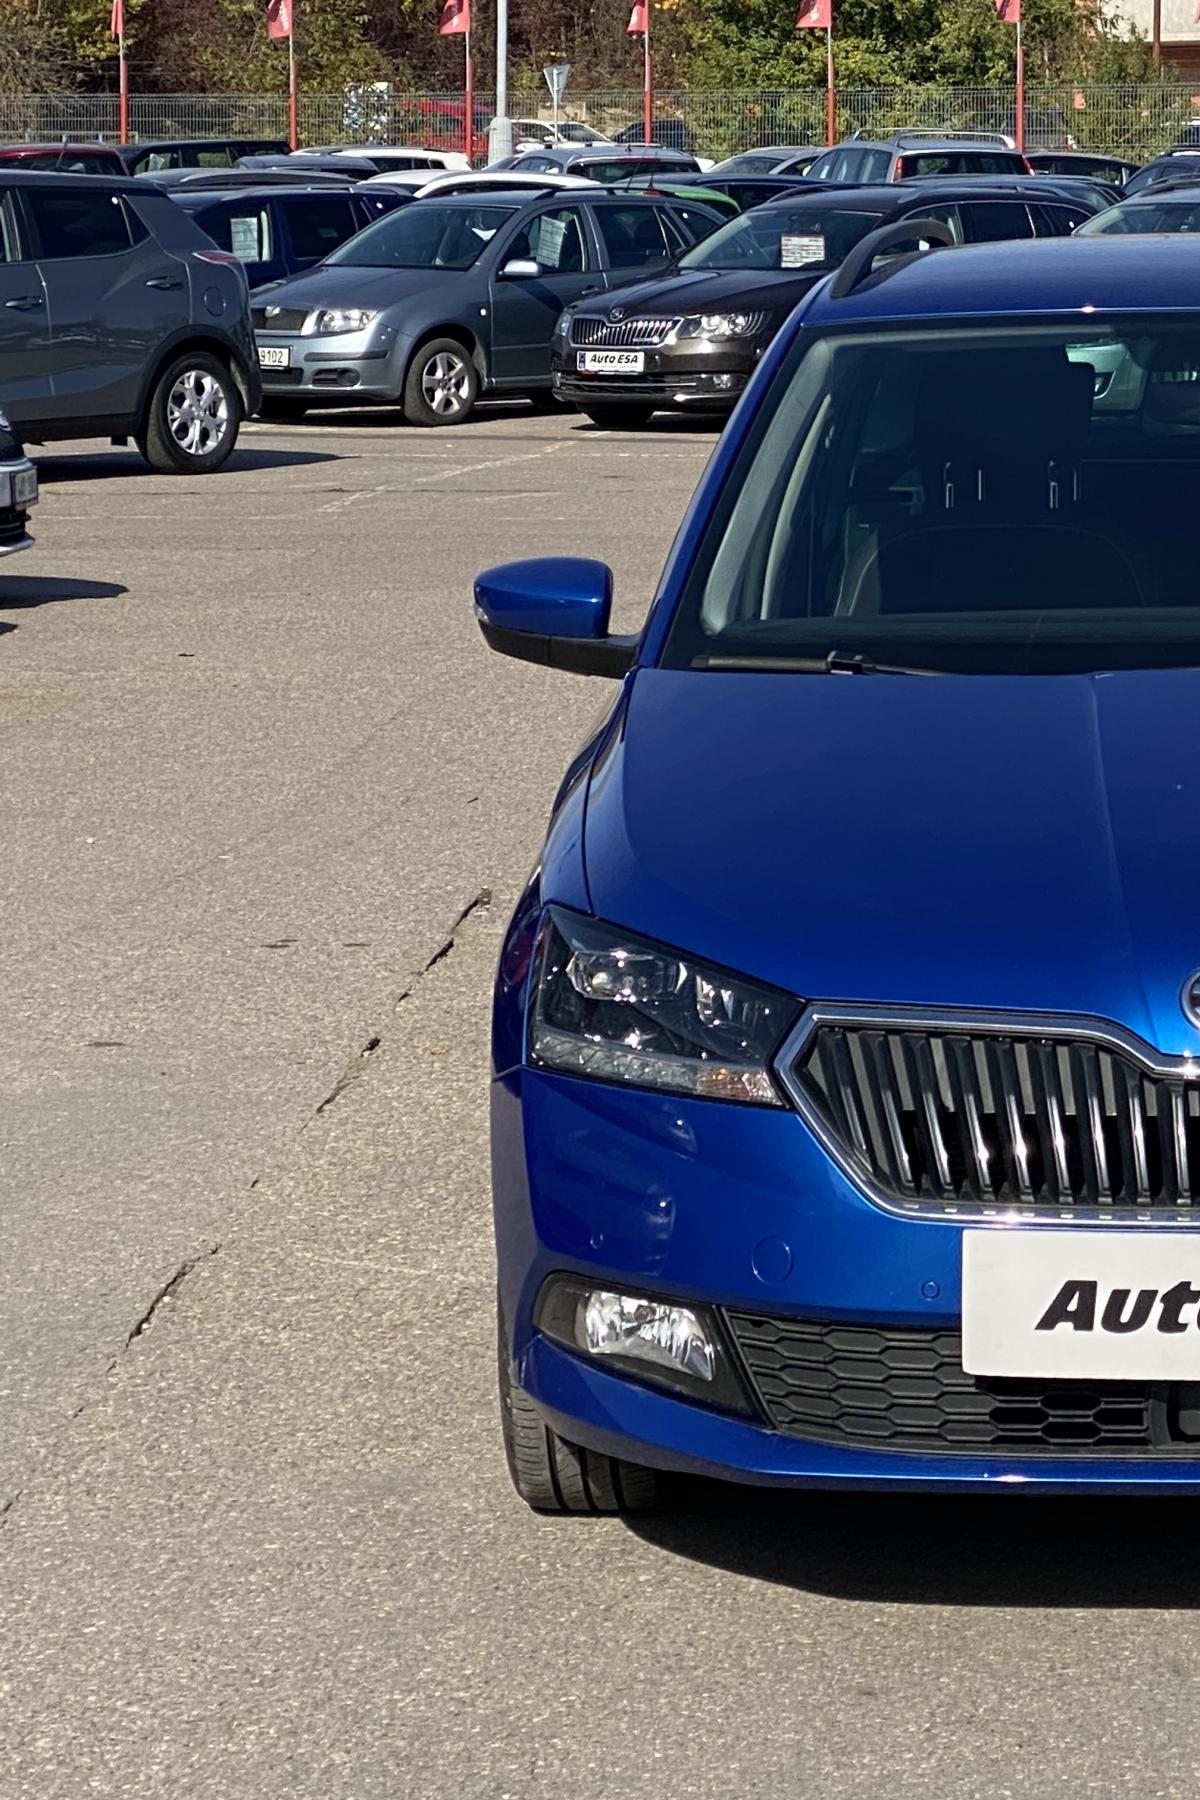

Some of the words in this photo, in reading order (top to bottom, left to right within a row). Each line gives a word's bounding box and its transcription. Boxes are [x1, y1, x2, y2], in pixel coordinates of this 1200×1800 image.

[260, 350, 284, 364] 9102
[589, 353, 616, 364] Auto
[617, 354, 638, 364] ESA
